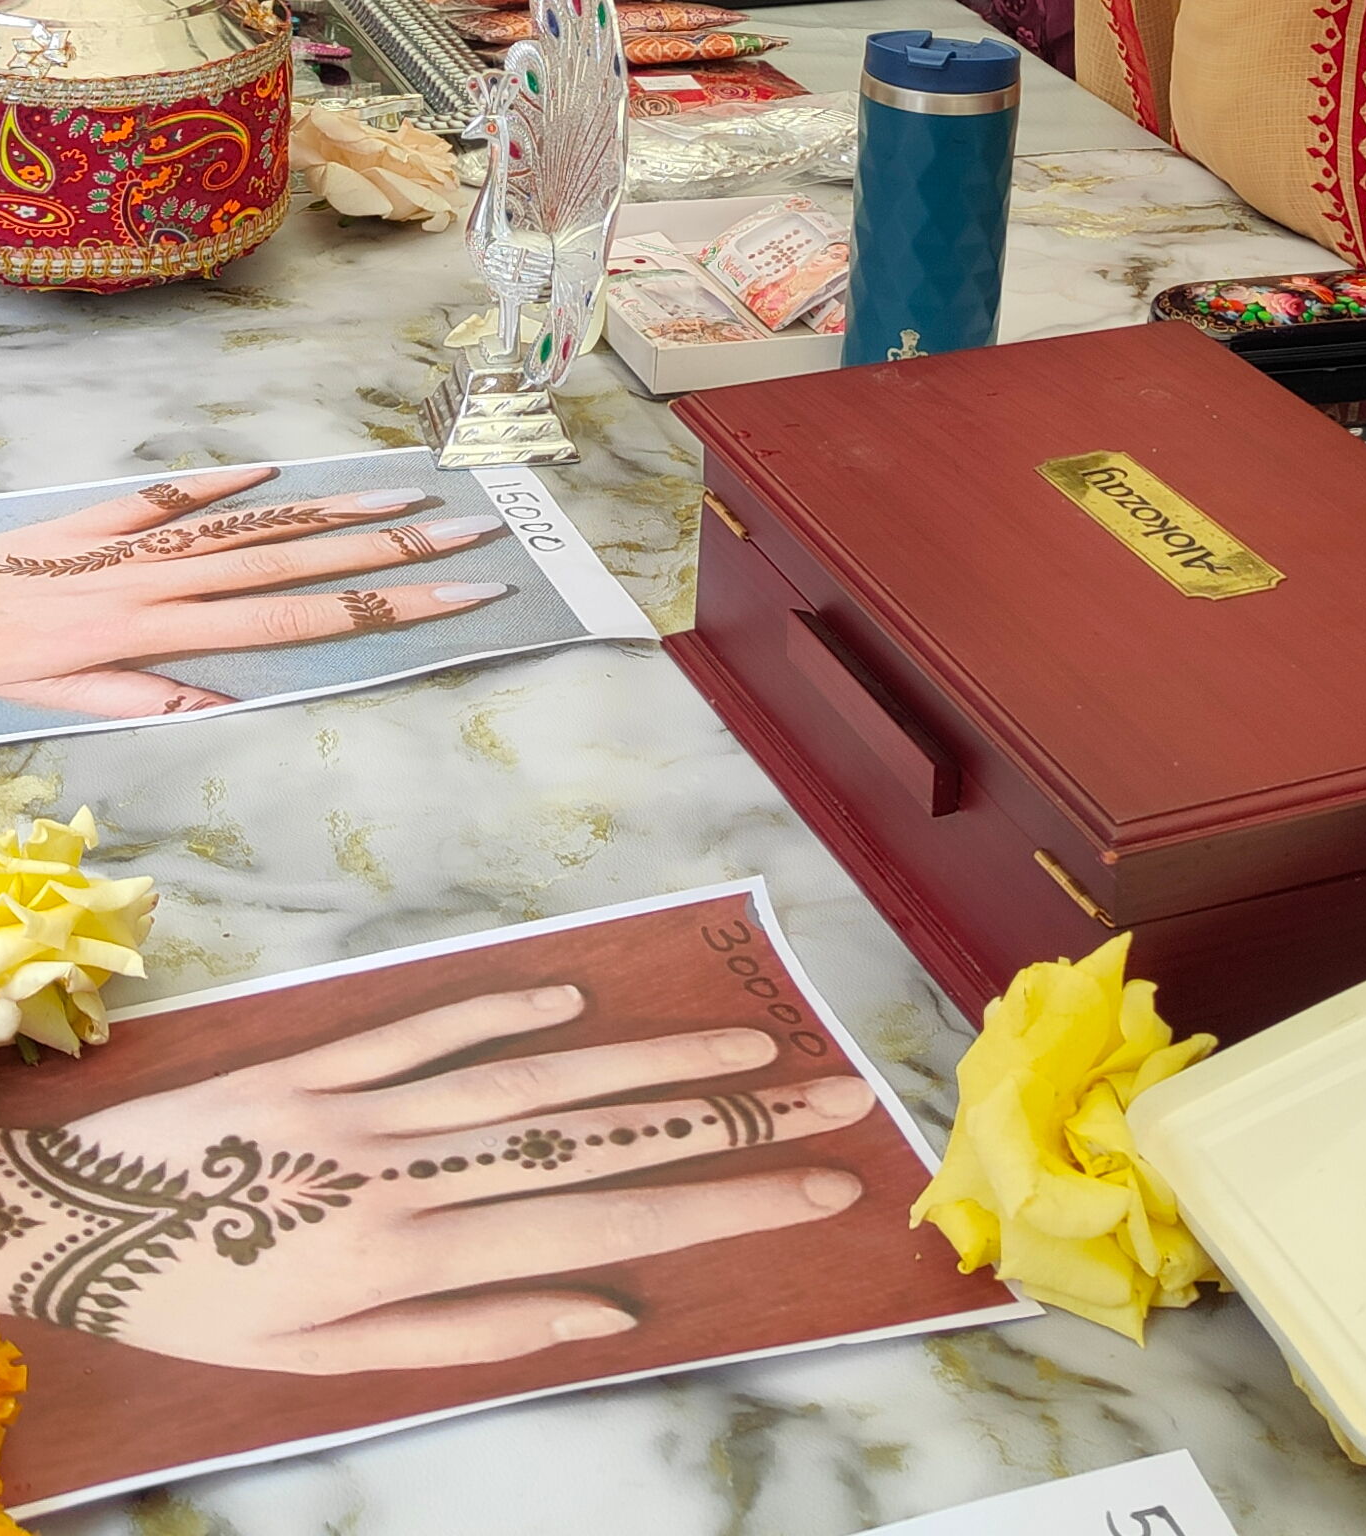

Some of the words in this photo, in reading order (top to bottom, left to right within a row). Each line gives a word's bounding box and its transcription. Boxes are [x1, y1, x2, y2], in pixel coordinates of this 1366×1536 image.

[487, 482, 567, 552] 15000
[1081, 466, 1234, 575] Alokozay
[701, 920, 828, 1058] 30000
